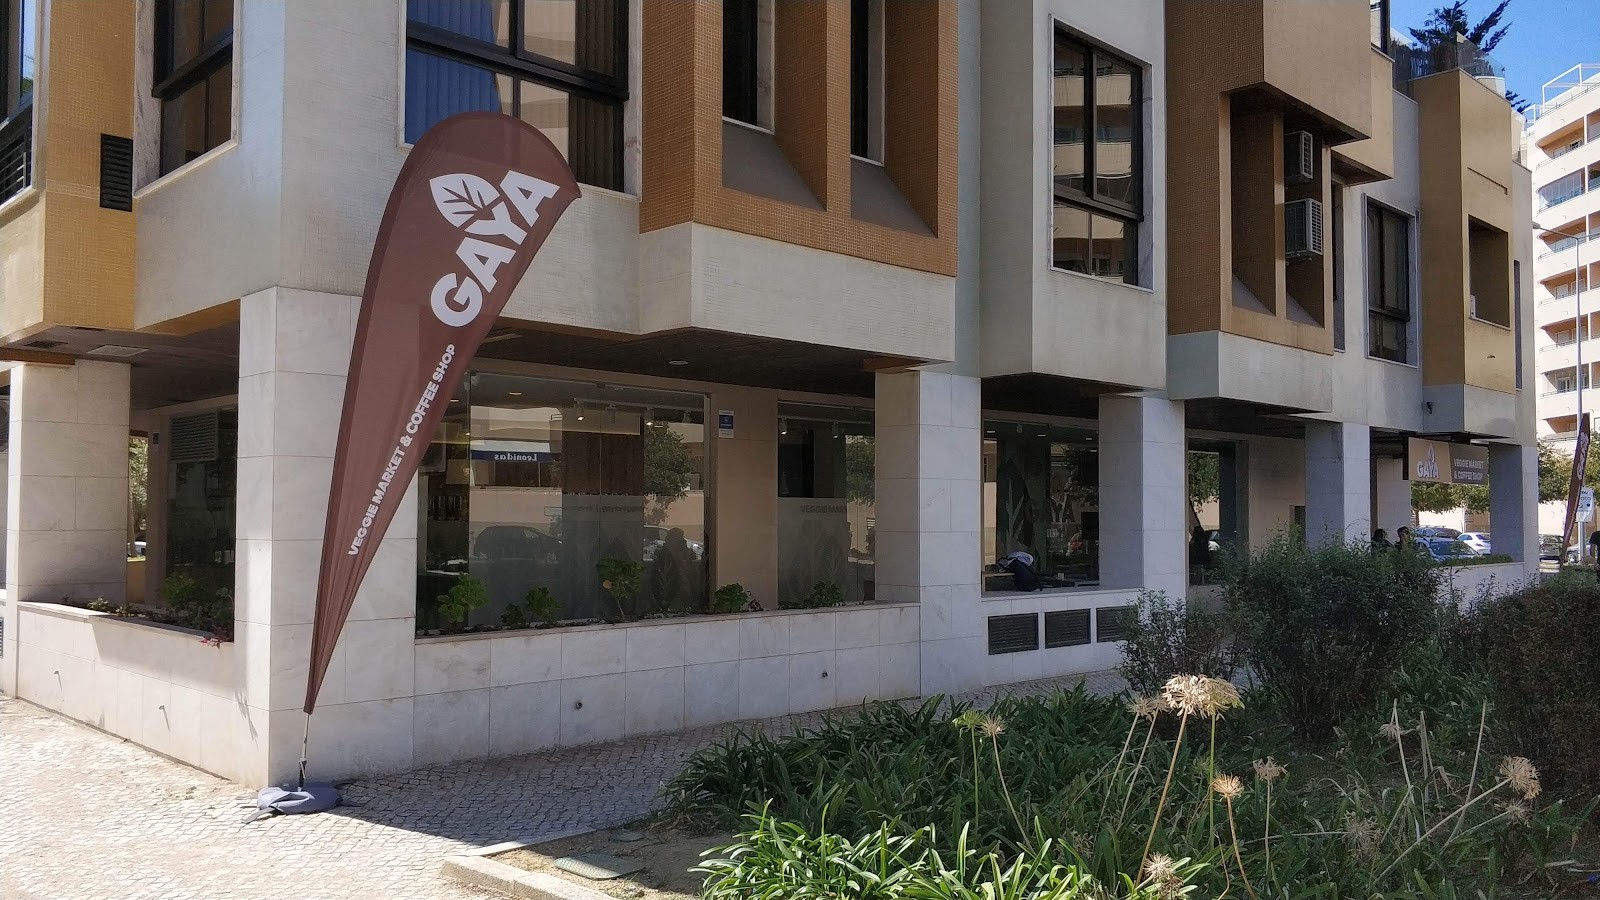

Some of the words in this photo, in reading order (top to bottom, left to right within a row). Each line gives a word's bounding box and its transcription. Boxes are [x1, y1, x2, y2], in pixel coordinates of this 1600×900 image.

[431, 170, 560, 327] GAYA
[432, 343, 455, 382] SHOP
[406, 381, 439, 434] COFFEE
[400, 435, 413, 447] &
[372, 446, 405, 504] MARKET
[1417, 460, 1439, 478] GAYA
[1454, 459, 1469, 468] VEGGIE
[1469, 460, 1484, 469] MARKET
[1458, 471, 1473, 480] COFFEE
[1473, 472, 1483, 481] SHOP
[348, 504, 379, 555] VEGGIE
